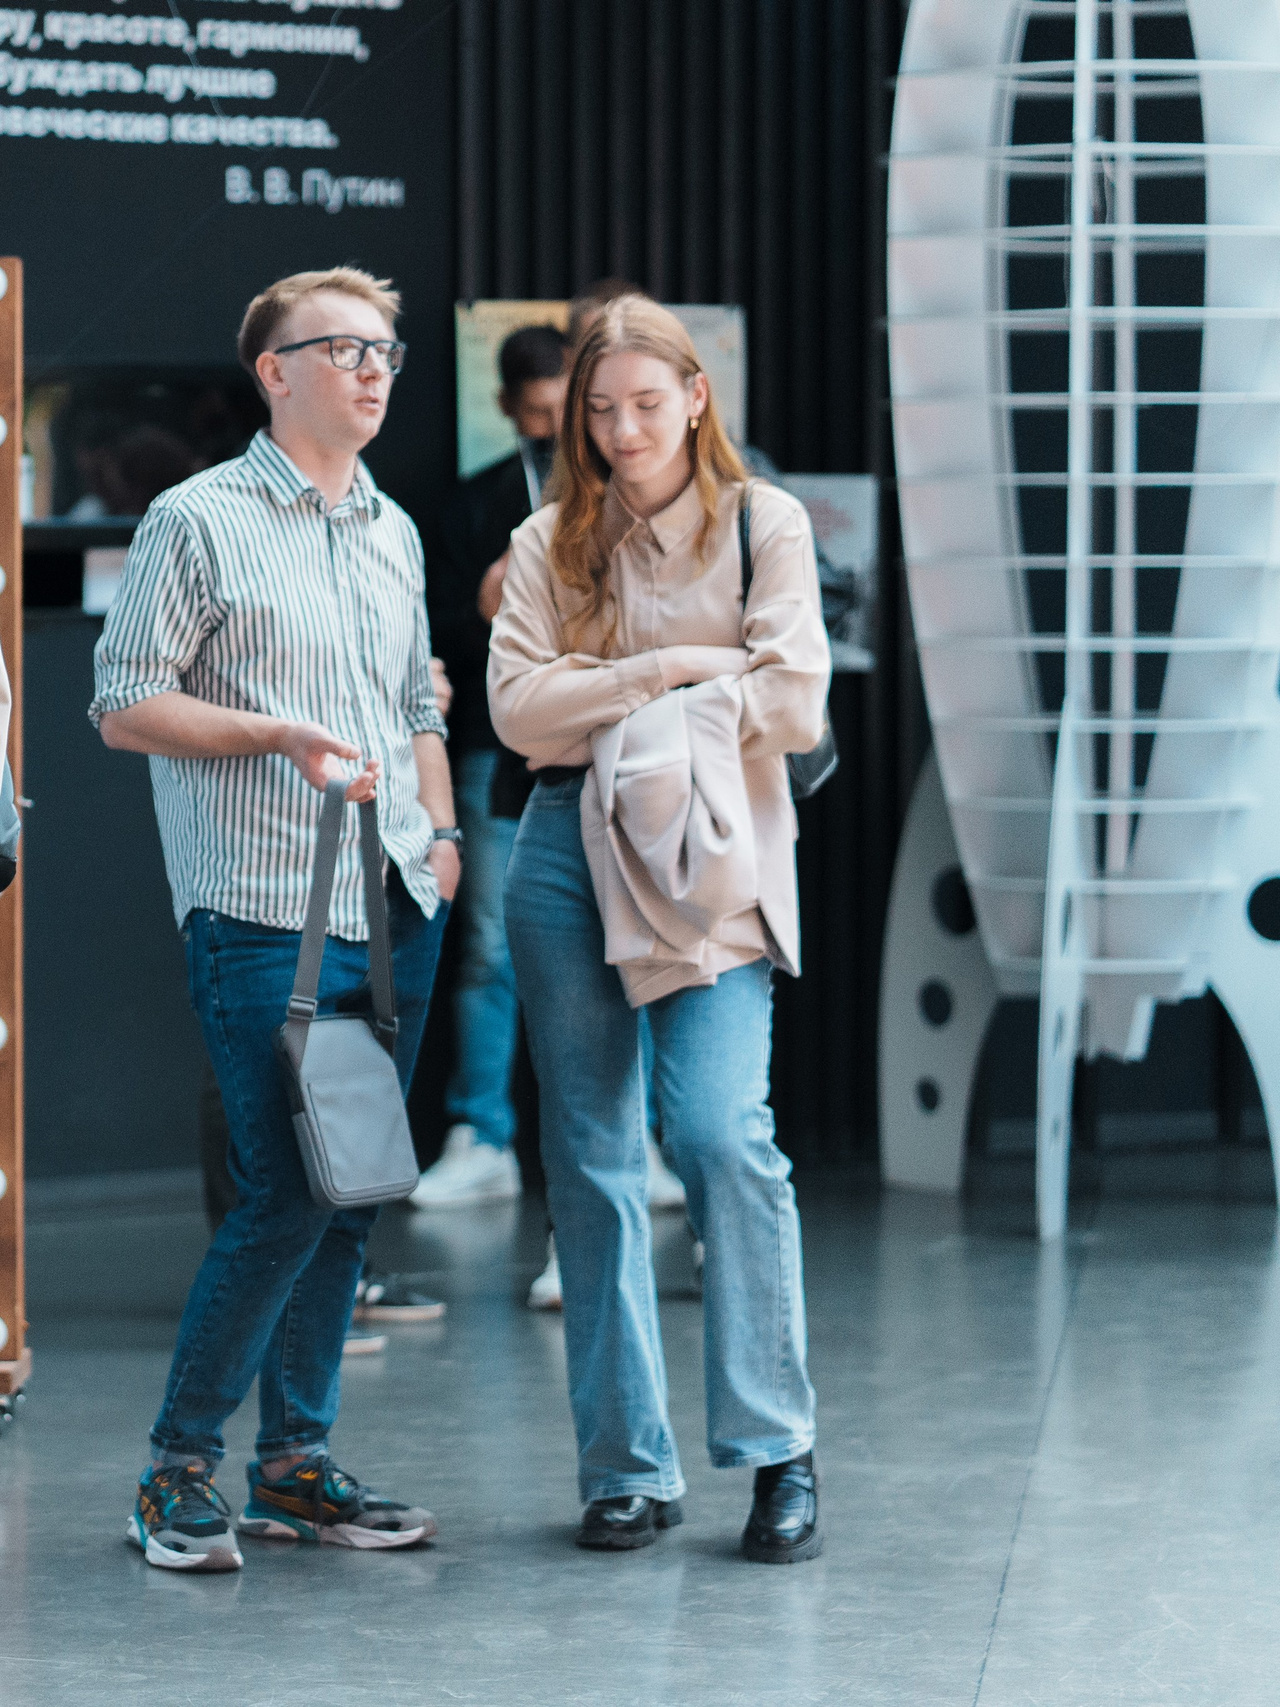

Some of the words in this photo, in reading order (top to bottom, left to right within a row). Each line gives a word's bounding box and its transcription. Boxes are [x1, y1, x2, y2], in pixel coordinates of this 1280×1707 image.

[144, 63, 276, 103] лучшие
[225, 165, 261, 204] В.
[263, 166, 300, 205] В.
[301, 167, 406, 214] Путин
